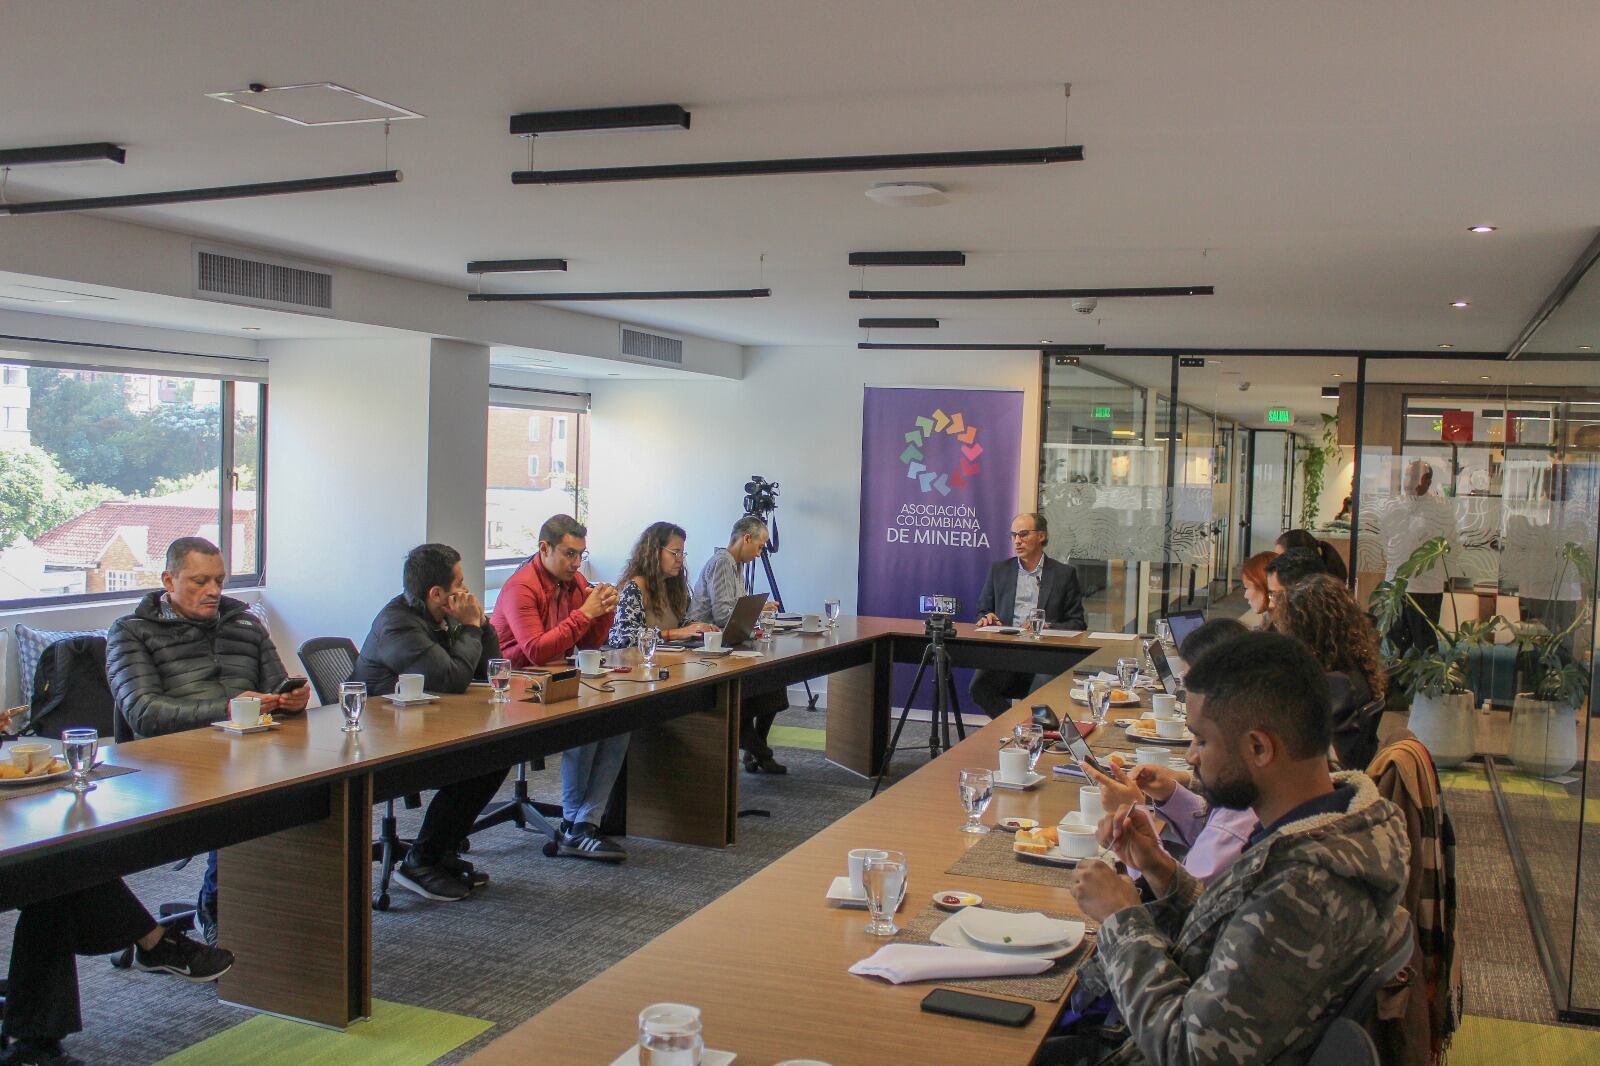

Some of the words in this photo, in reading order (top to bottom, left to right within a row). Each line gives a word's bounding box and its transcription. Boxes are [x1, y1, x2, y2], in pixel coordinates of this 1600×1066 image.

[900, 503, 976, 517] ASOCIACIÓN
[896, 514, 981, 530] COLOMBIANA
[887, 527, 910, 543] DE
[913, 528, 990, 548] MINERÍA
